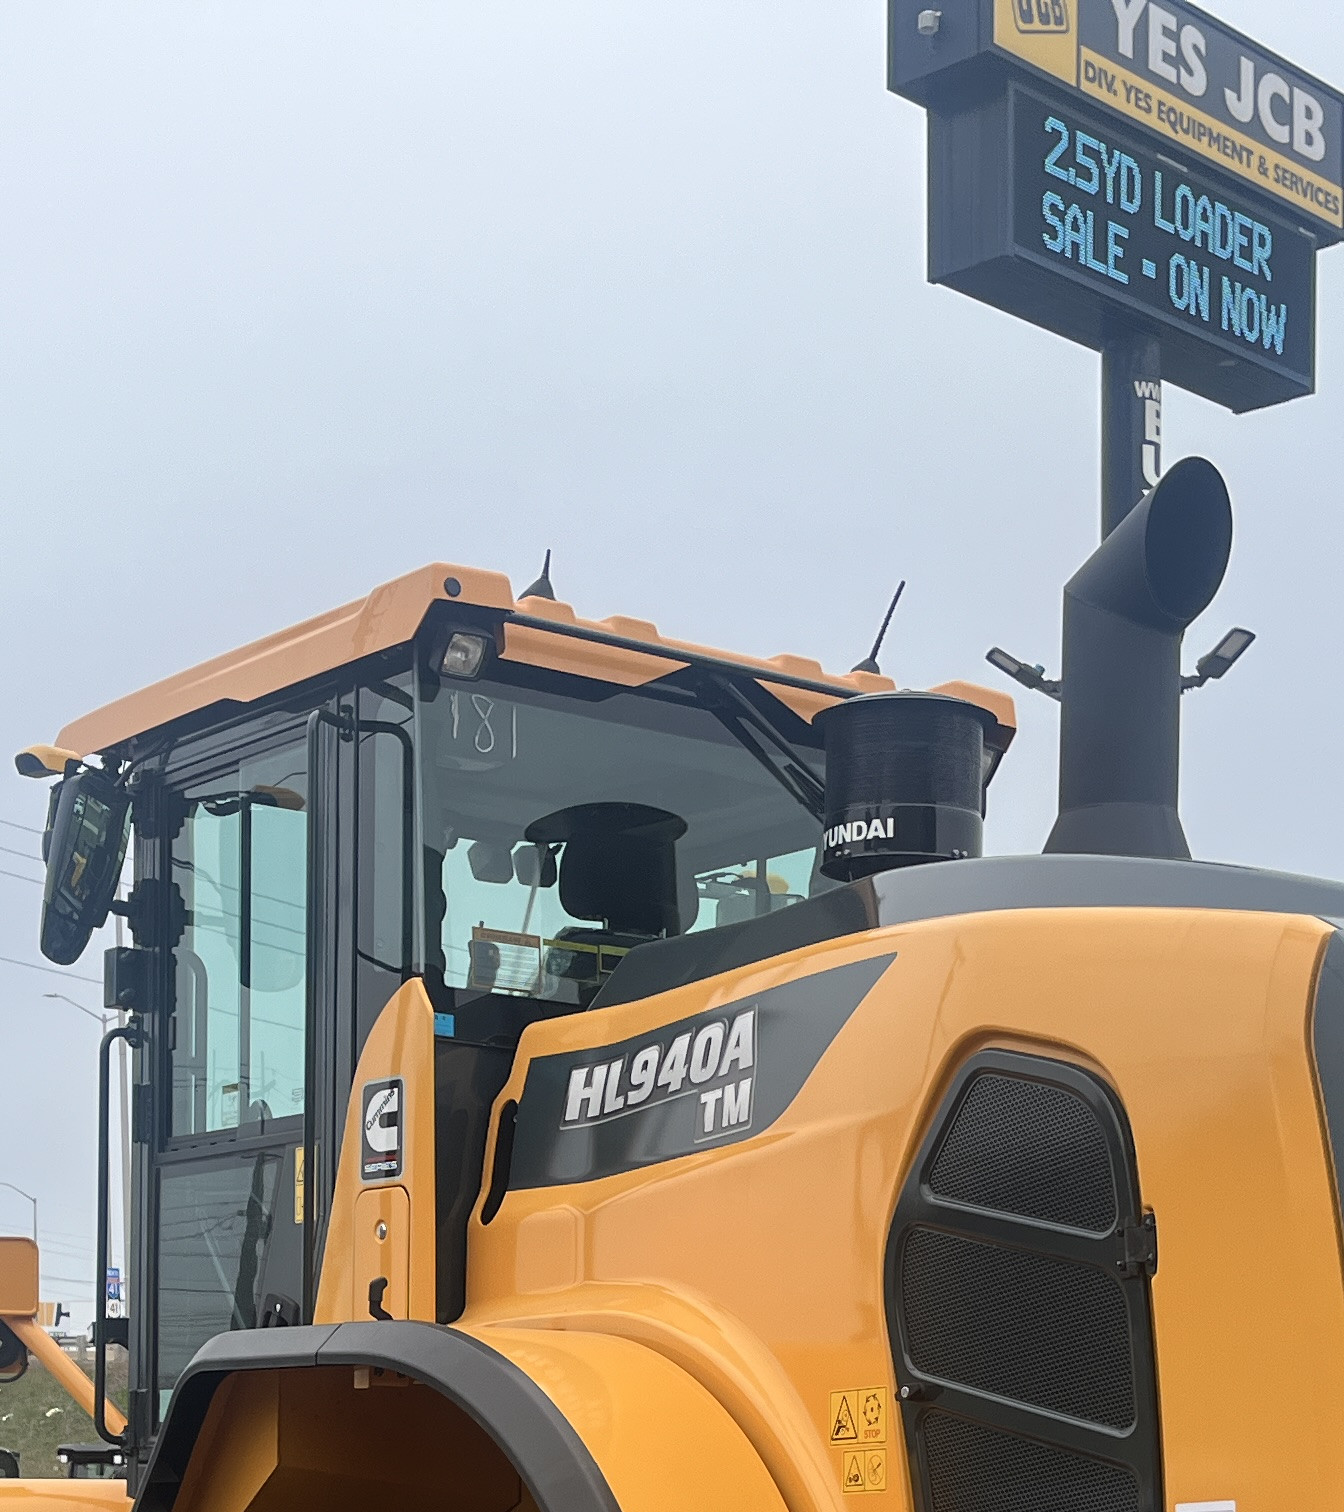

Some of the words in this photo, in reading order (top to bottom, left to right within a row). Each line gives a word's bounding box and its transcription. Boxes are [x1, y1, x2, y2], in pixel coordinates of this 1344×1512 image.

[1112, 0, 1207, 97] YES
[1224, 56, 1326, 162] JCB
[1084, 59, 1118, 97] DIV.
[1122, 79, 1153, 115] YES
[1157, 98, 1254, 170] EQUIPMENT
[1258, 155, 1270, 179] &
[1273, 163, 1340, 216] SERVICES
[1154, 170, 1272, 281] LOADER
[1042, 191, 1129, 284] SALE
[1169, 253, 1209, 321] ON
[1221, 276, 1287, 355] NOW
[450, 690, 517, 759] 181
[823, 817, 895, 851] YUNDAI
[366, 1087, 396, 1131] Cummins
[565, 1010, 755, 1122] HL940A
[700, 1077, 752, 1133] TM
[864, 1429, 880, 1440] STOP
